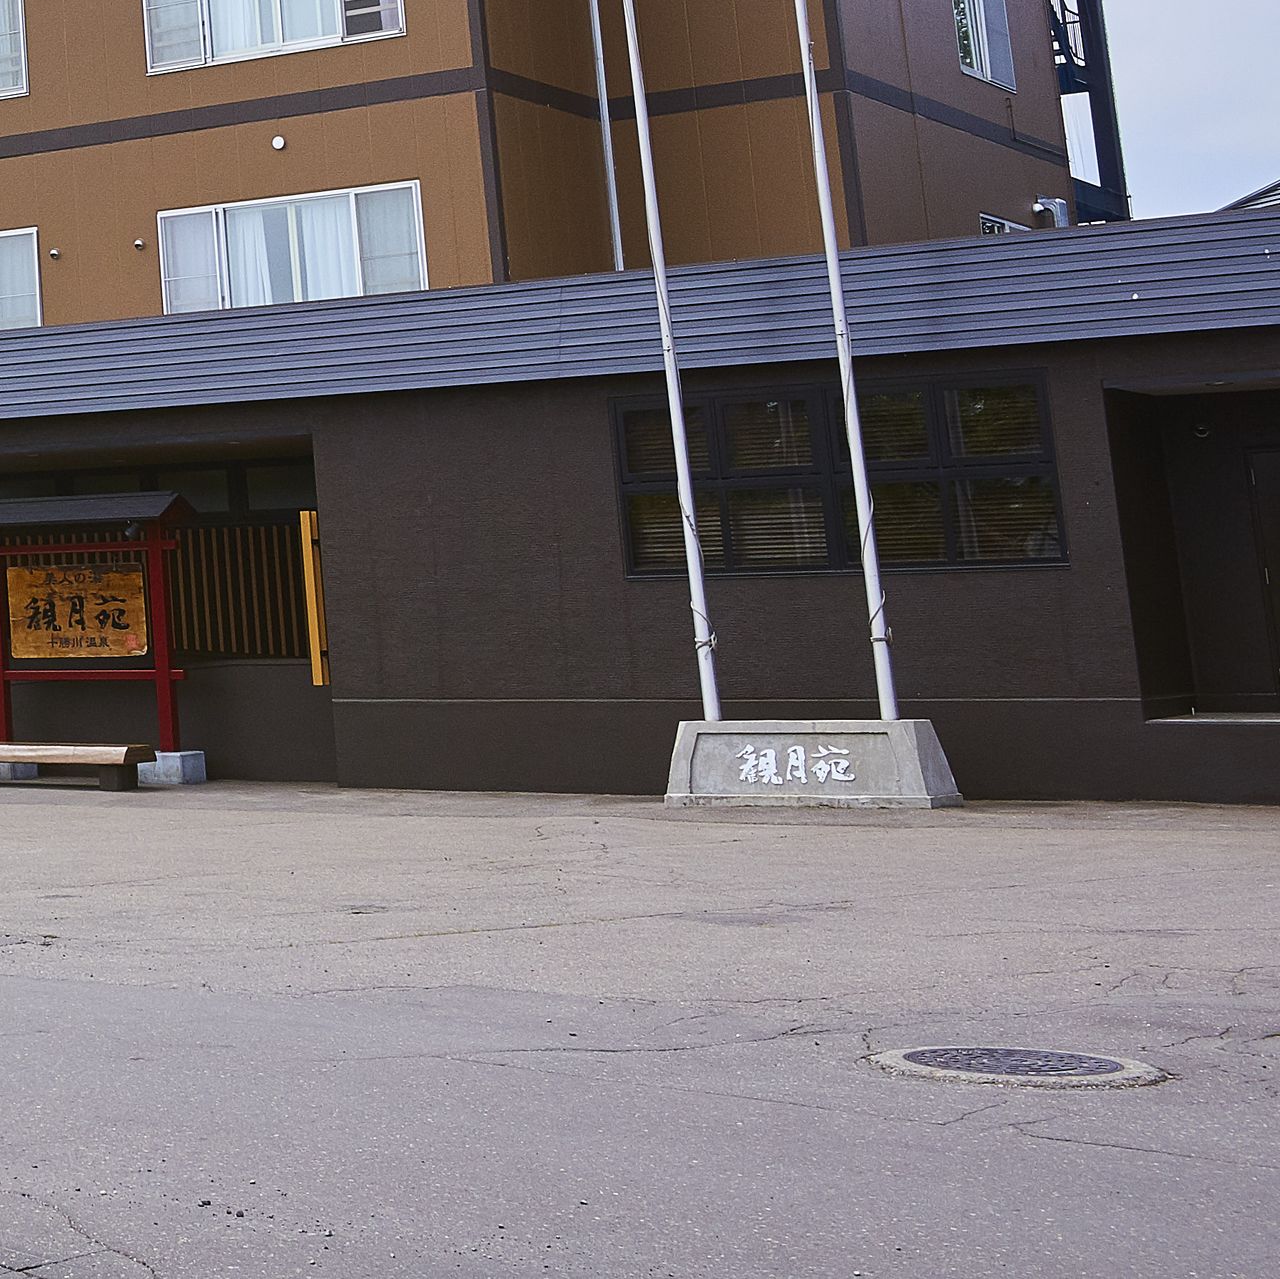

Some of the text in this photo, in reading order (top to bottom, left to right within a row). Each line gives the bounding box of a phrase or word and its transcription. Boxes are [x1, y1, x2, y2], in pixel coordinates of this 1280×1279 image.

[24, 593, 130, 632] 観月苑
[735, 744, 856, 786] 観月苑
